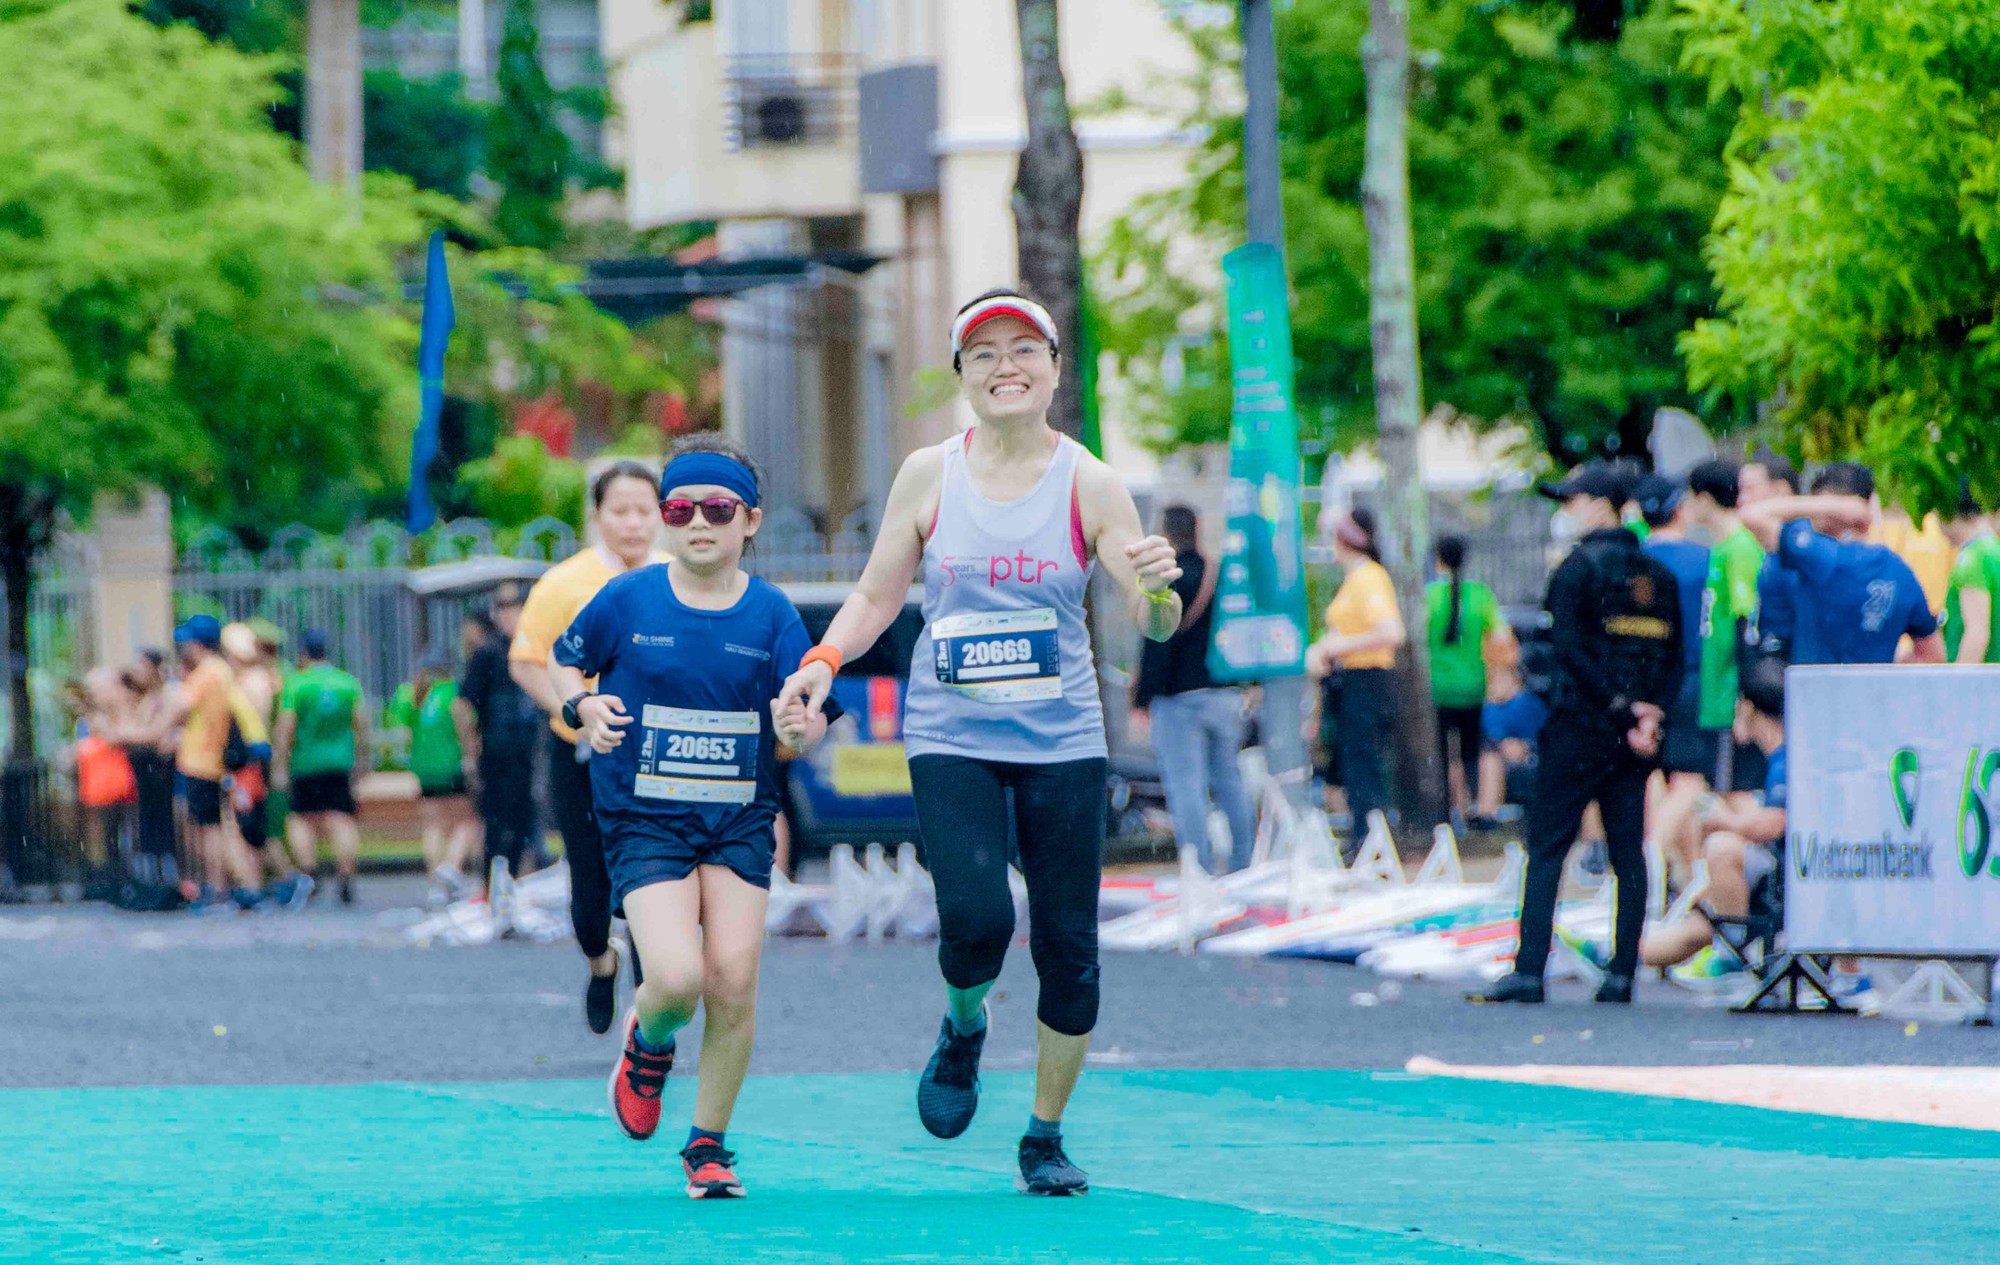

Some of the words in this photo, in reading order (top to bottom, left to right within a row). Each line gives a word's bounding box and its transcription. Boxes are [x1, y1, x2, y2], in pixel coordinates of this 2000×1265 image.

[990, 549, 1059, 588] ptr
[961, 638, 1032, 667] 20669
[666, 734, 737, 761] 20653
